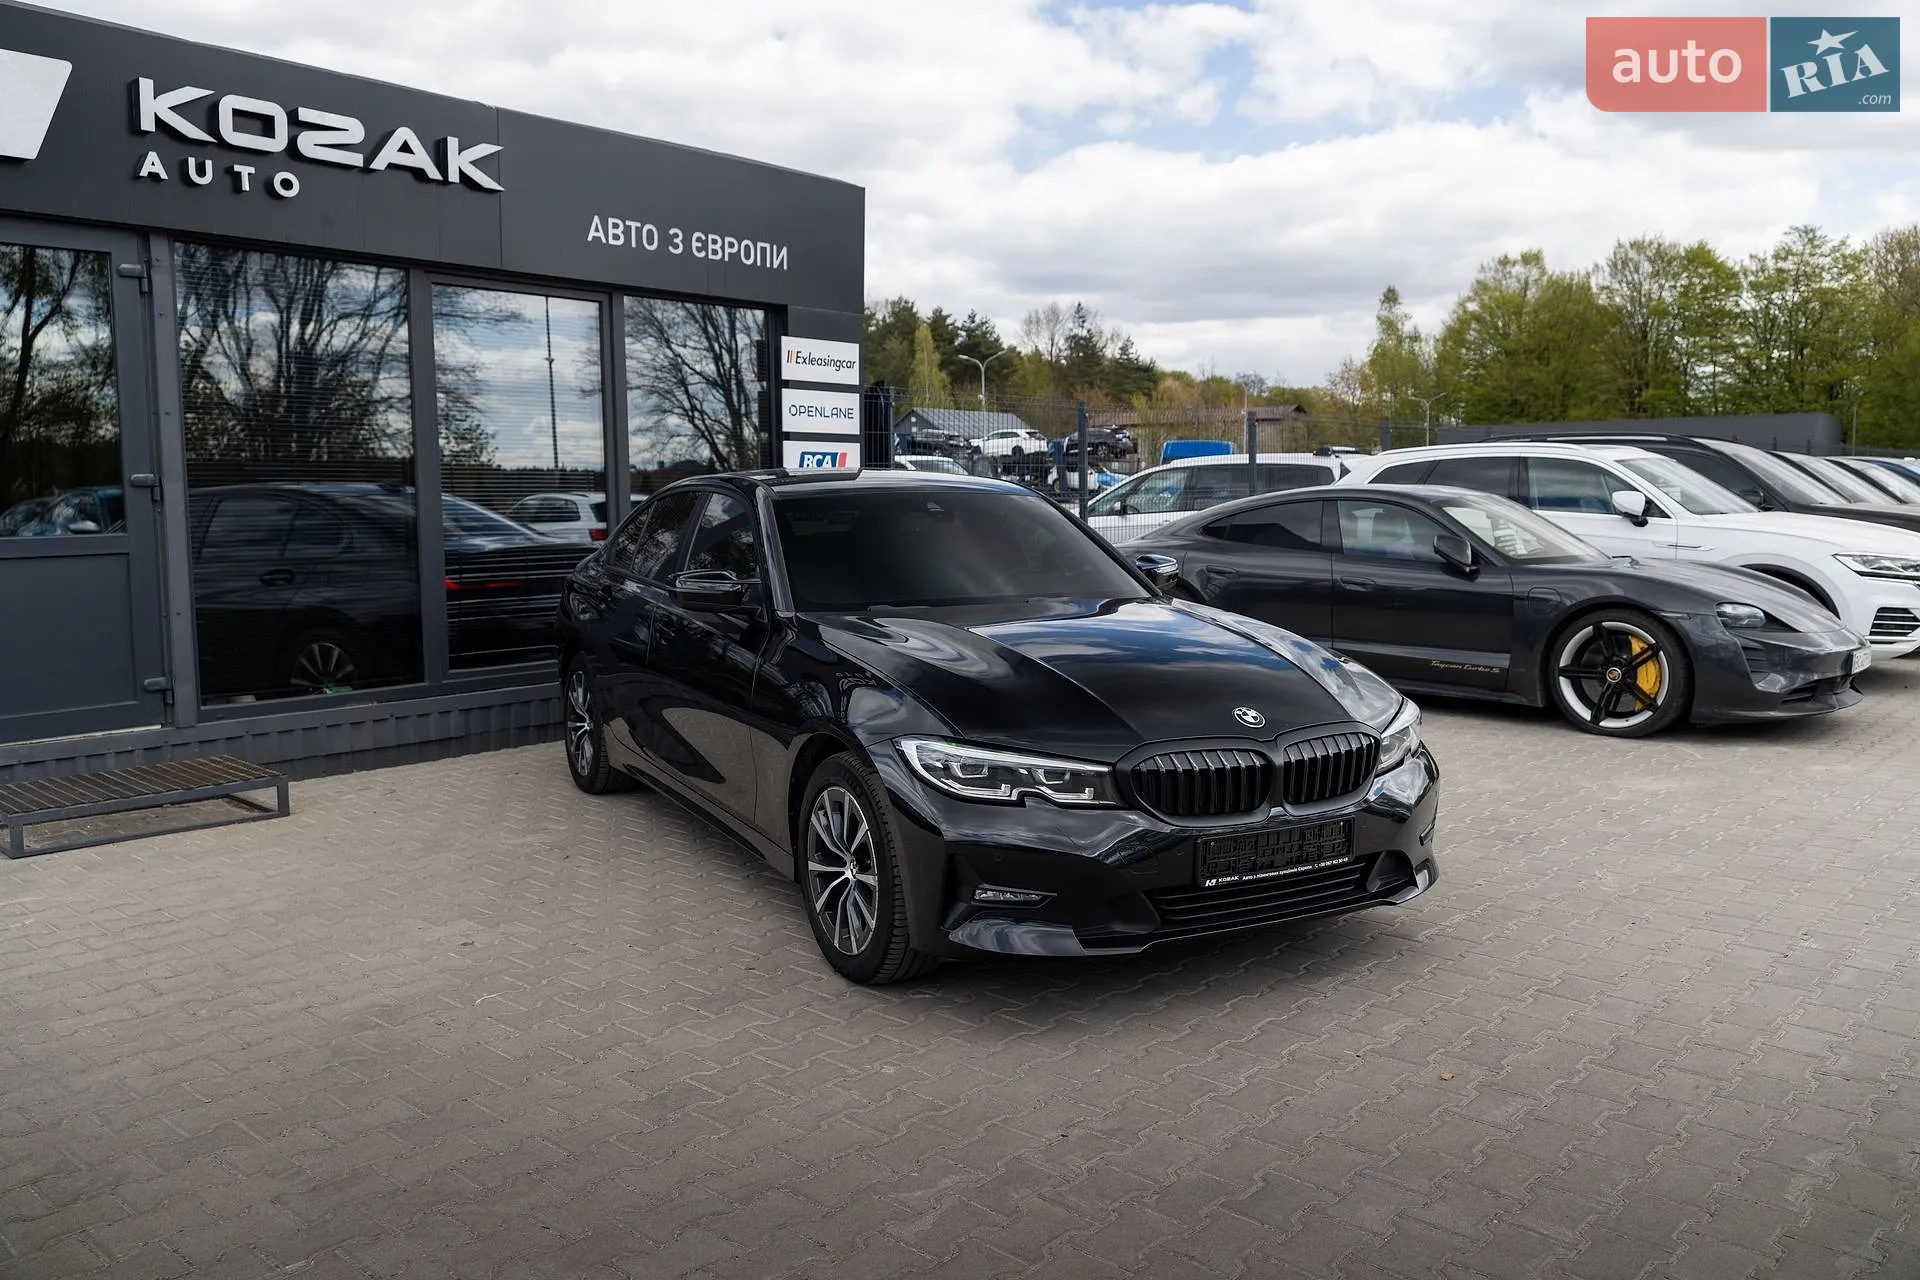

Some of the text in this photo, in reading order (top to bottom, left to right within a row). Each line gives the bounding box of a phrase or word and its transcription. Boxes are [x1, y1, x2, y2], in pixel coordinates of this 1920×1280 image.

[136, 76, 505, 192] KOZAK
[138, 150, 300, 199] AUTO
[587, 214, 788, 271] АВТО З ЄВРОПИ
[795, 350, 857, 372] Exleasingcar
[788, 404, 855, 420] OPENLANE
[803, 454, 833, 468] BCA
